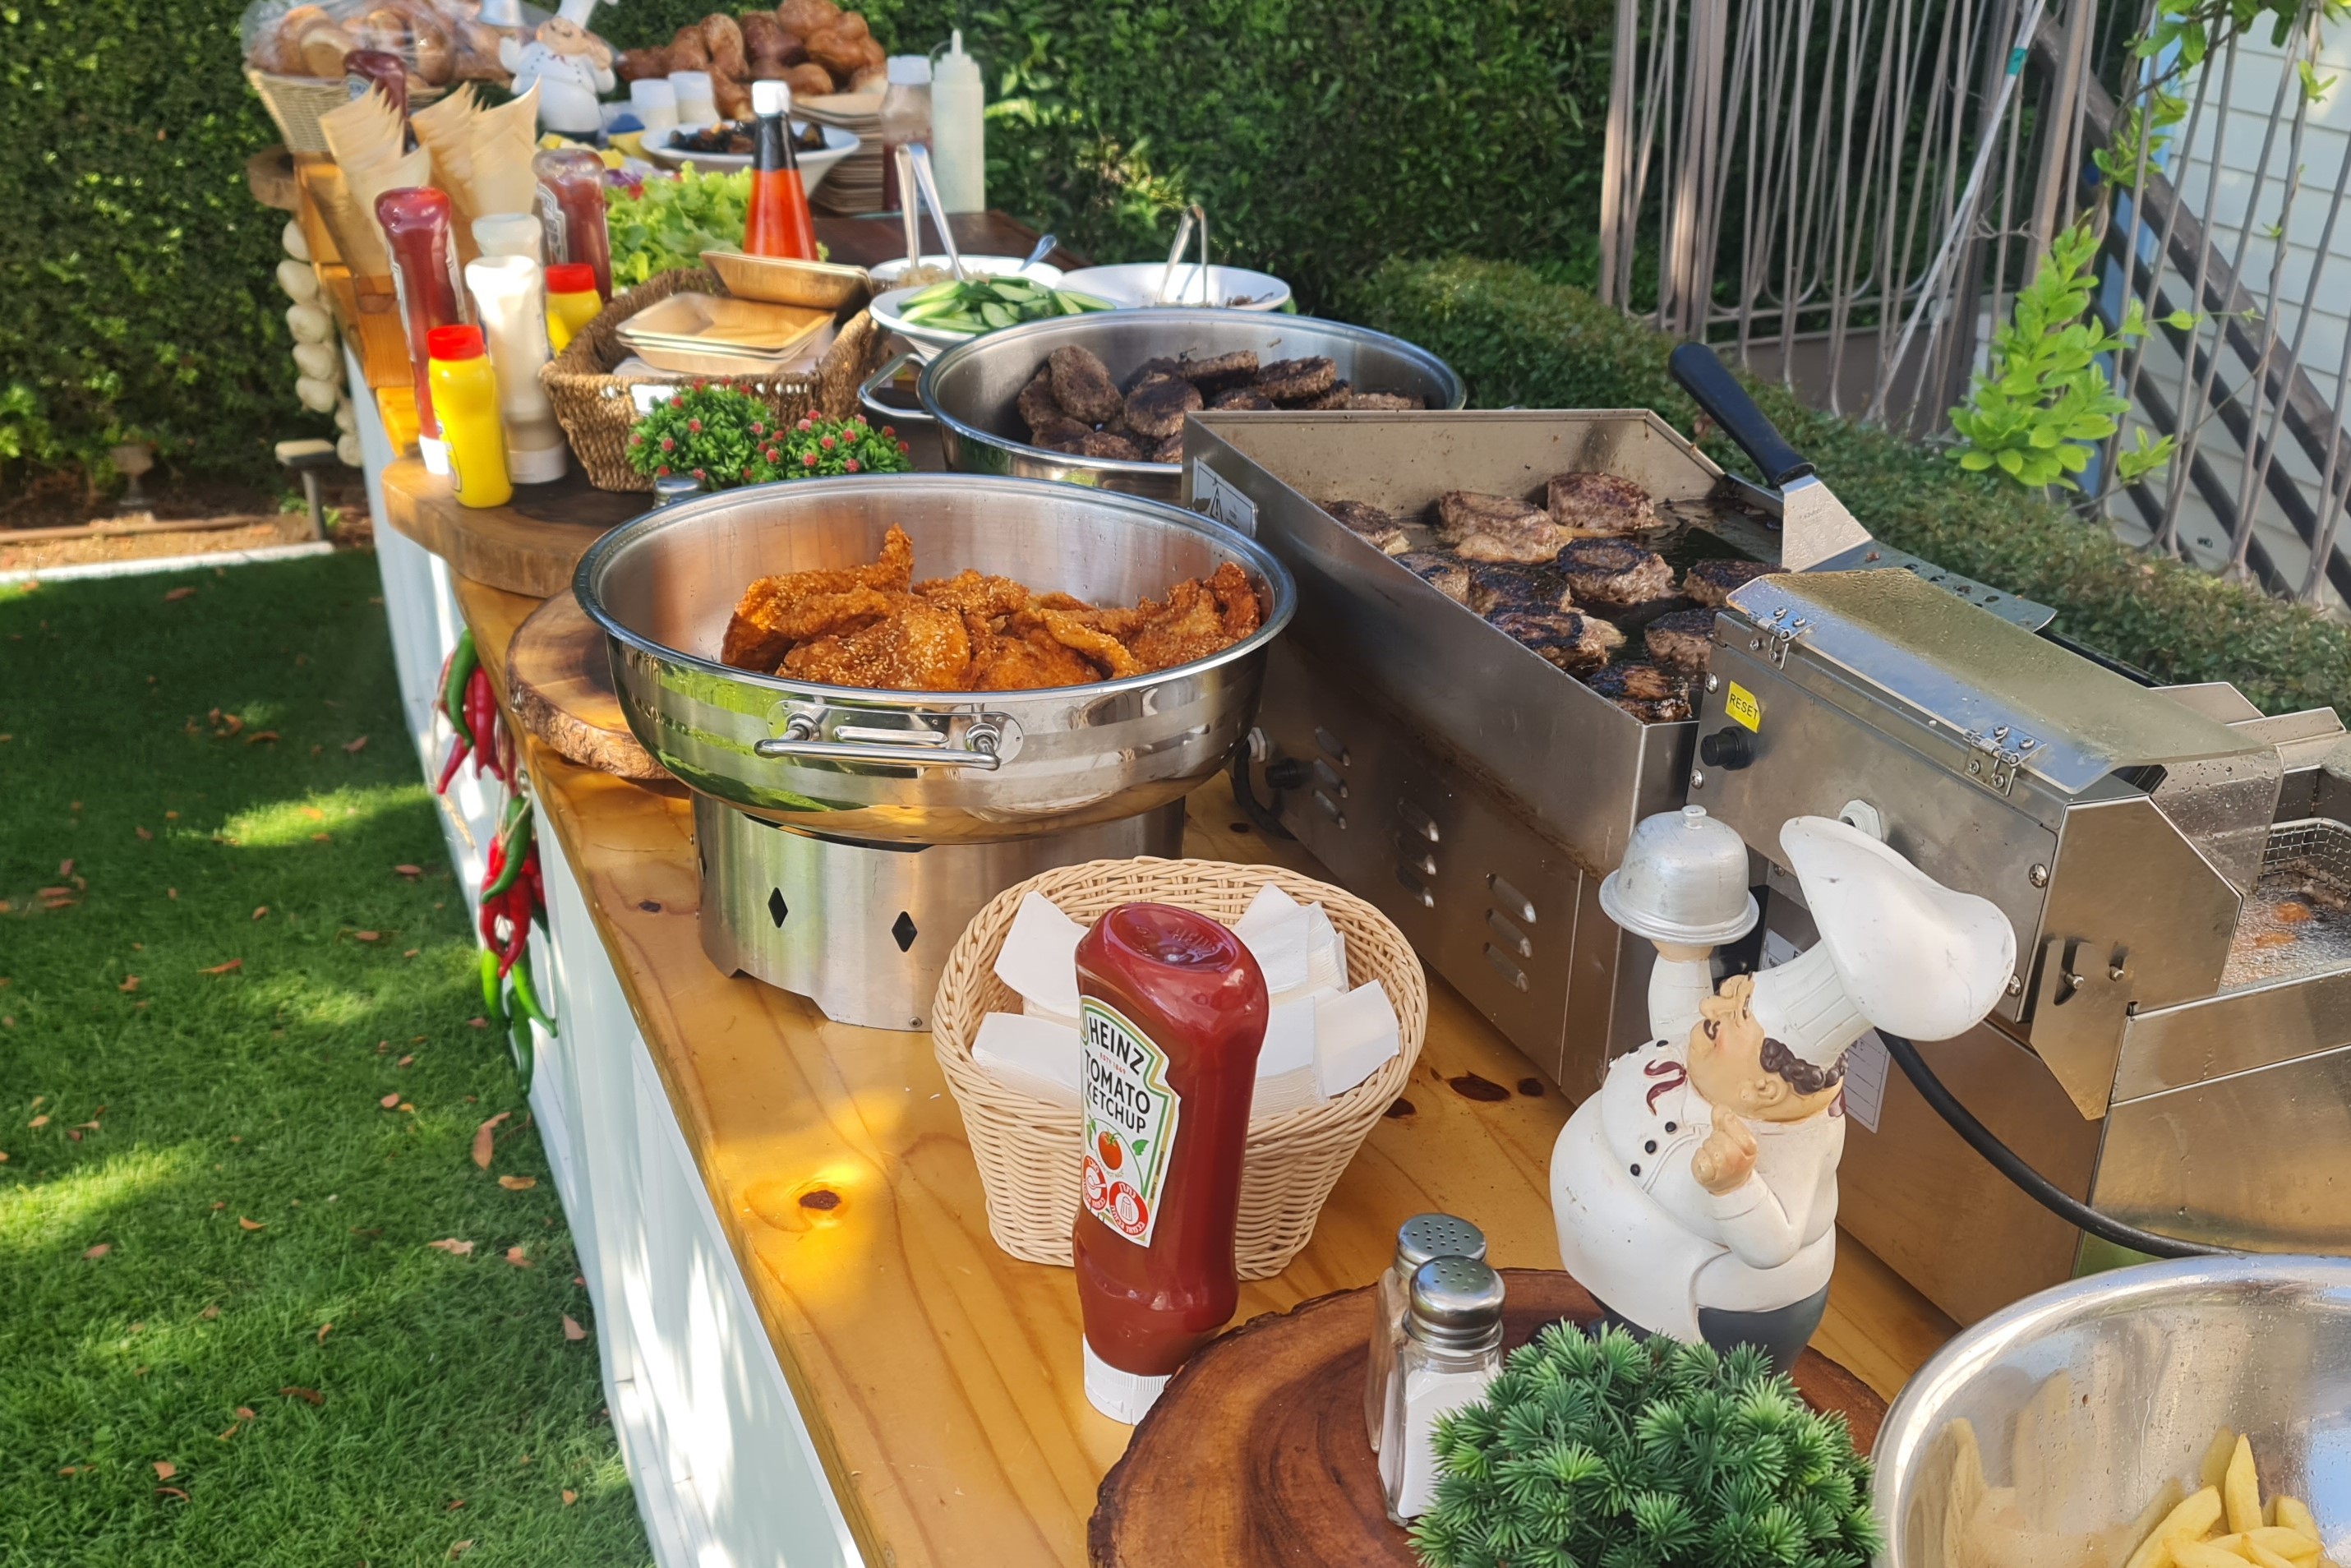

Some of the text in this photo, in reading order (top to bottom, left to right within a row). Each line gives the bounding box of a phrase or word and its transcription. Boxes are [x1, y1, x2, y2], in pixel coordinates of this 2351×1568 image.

[1729, 693, 1758, 720] RESET
[1089, 1017, 1145, 1076] HEINZ
[1113, 1062, 1127, 1075] 1869
[1085, 1049, 1150, 1114] TOMATO
[1087, 1077, 1146, 1133] KETCHUP
